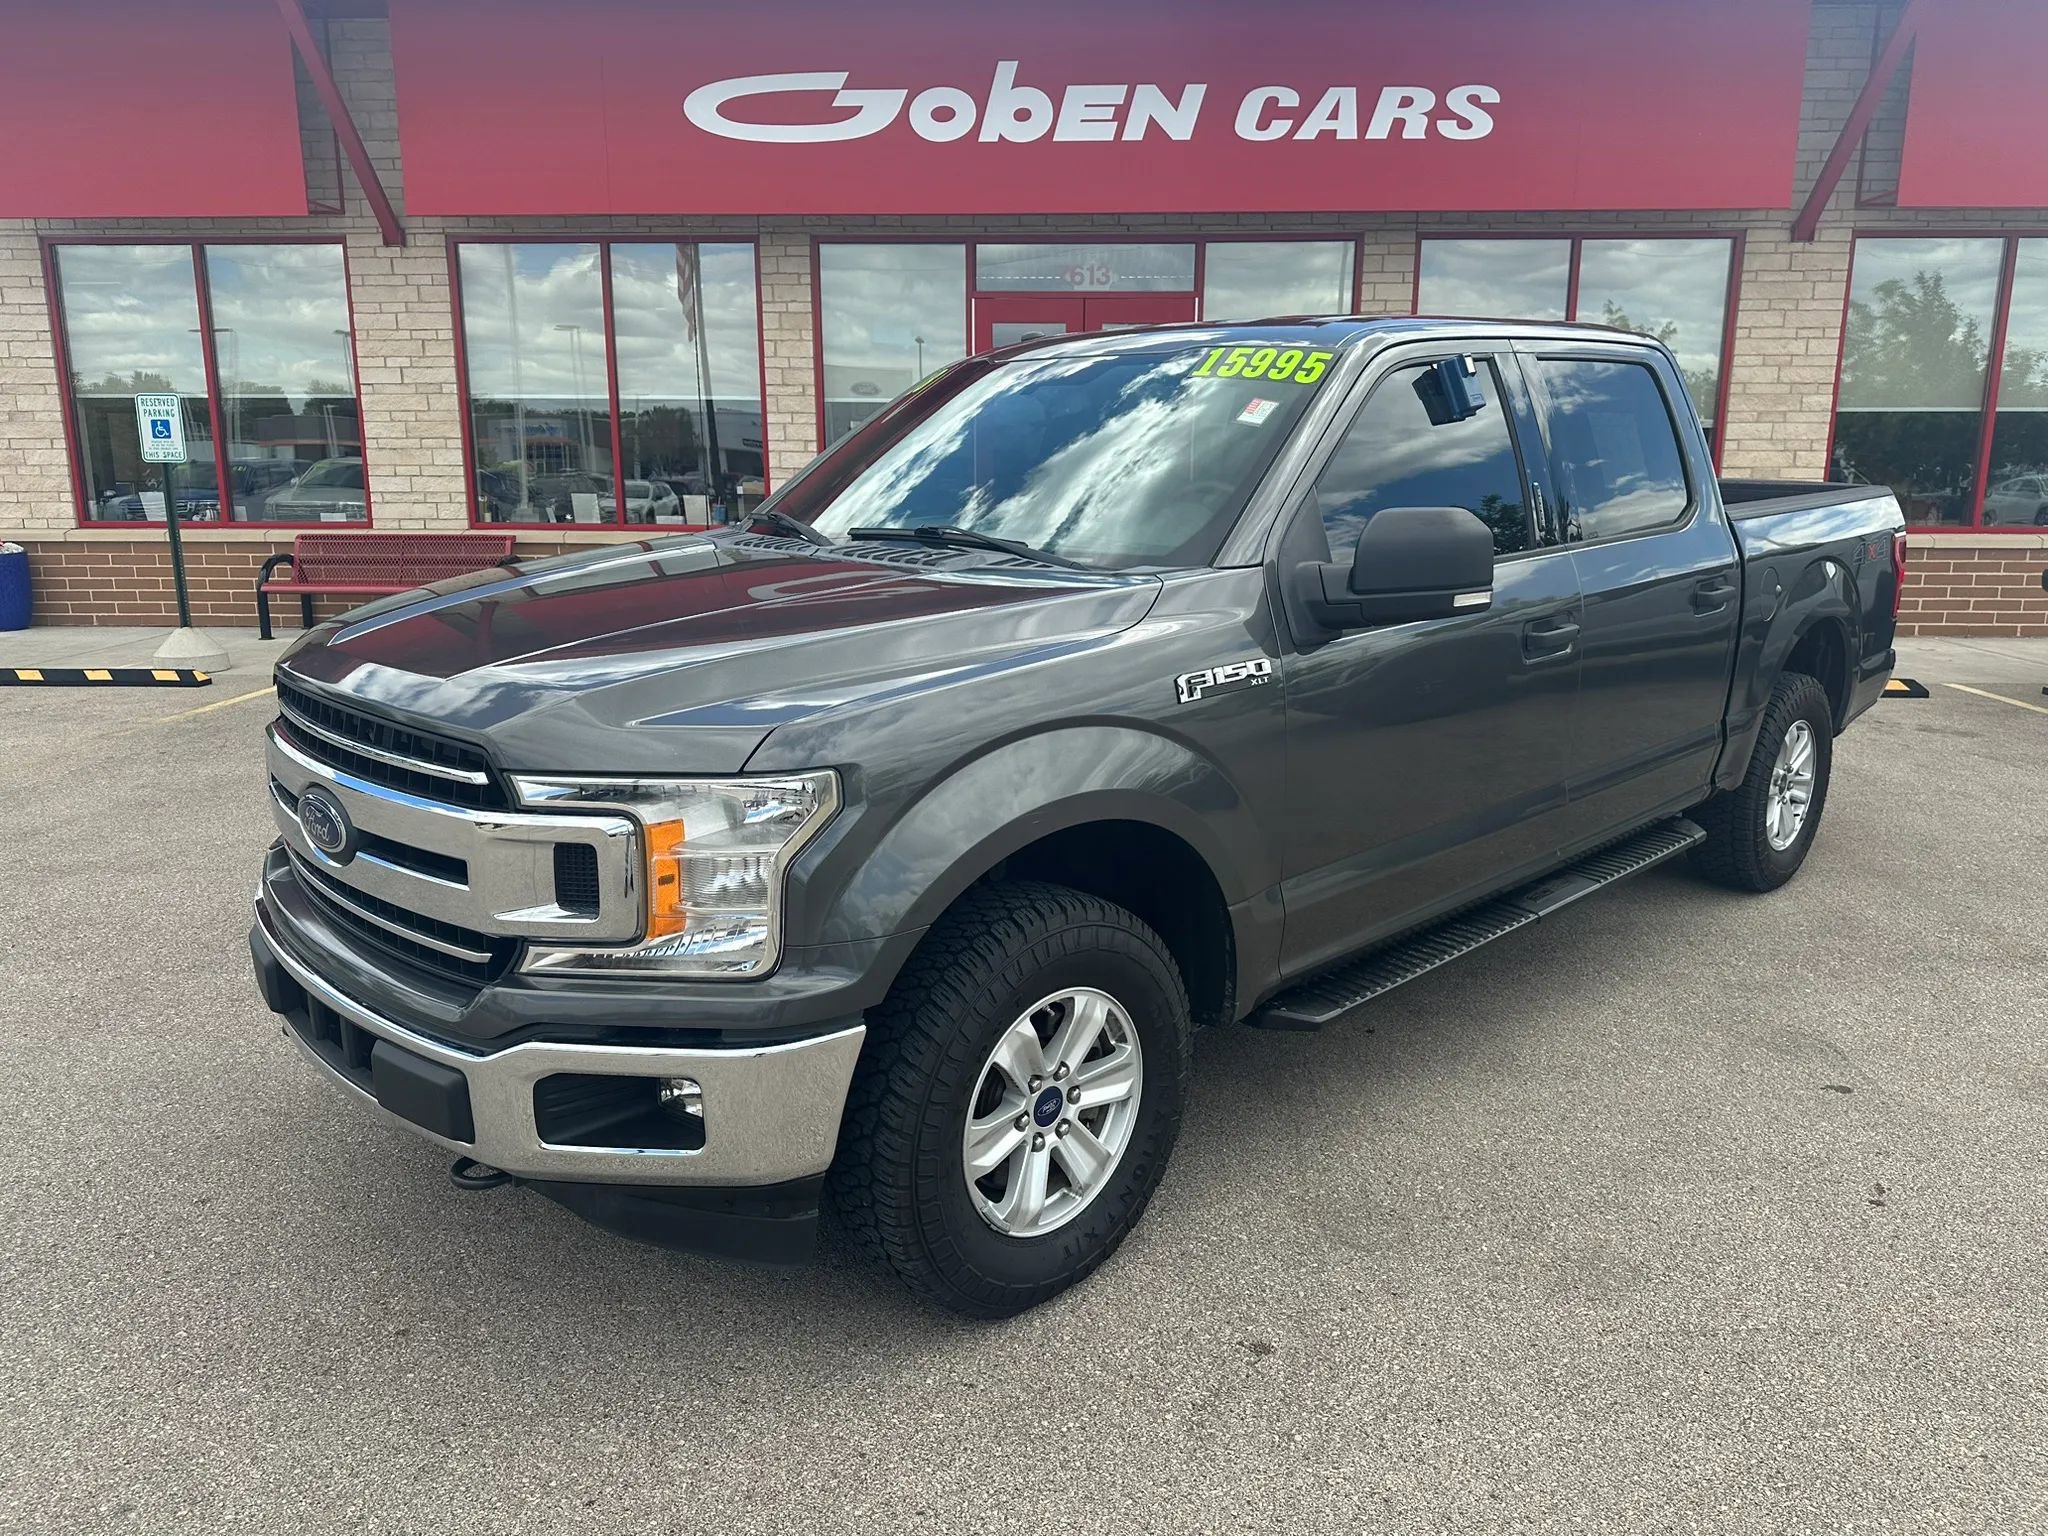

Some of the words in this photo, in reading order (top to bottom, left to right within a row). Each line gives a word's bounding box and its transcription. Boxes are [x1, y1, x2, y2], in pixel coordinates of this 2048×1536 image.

[1233, 84, 1501, 141] CARS
[1070, 265, 1111, 286] 613
[1191, 347, 1334, 384] 15995
[141, 398, 175, 407] RESERVED
[144, 409, 175, 418] PARKING
[145, 451, 160, 459] THIS
[163, 451, 183, 459] SPACE
[1250, 675, 1269, 687] XLT
[304, 805, 331, 842] Ford
